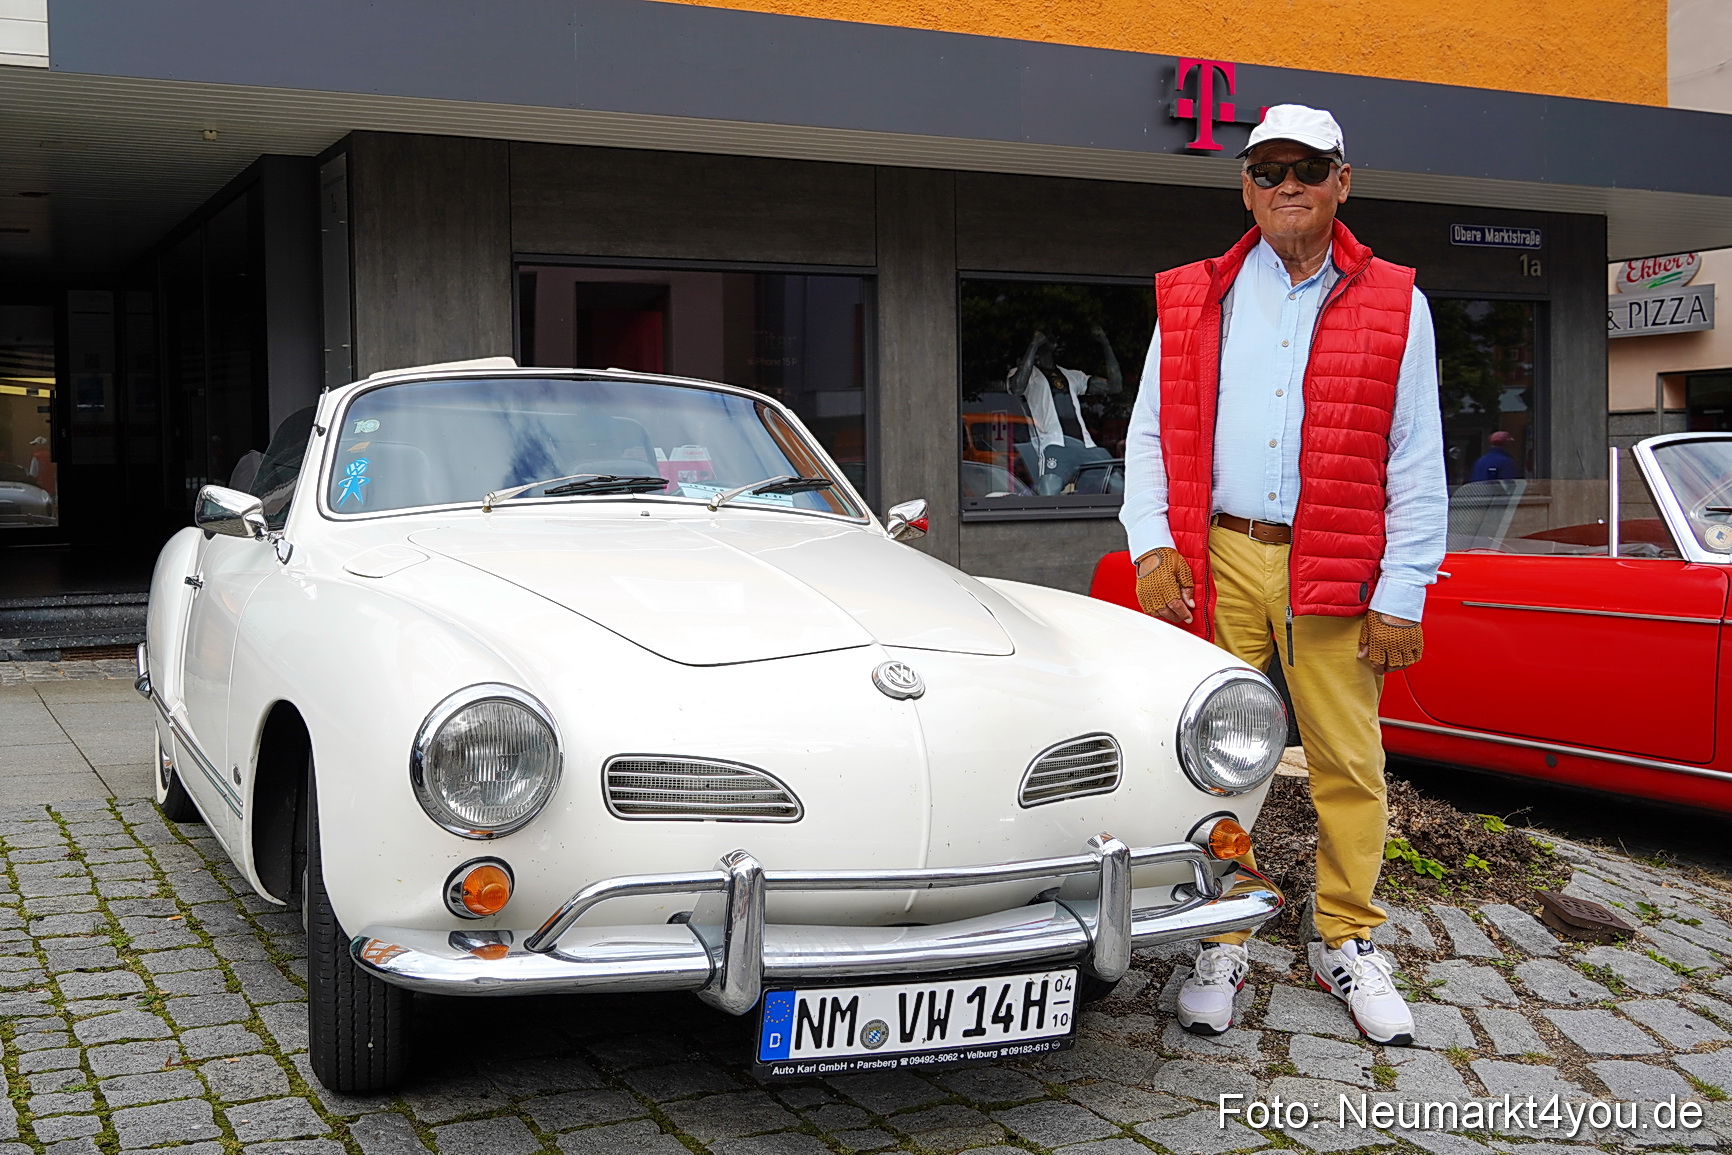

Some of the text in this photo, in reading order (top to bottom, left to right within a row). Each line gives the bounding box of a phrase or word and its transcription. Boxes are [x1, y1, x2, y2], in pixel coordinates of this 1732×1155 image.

[1177, 57, 1235, 151] T
[1454, 226, 1540, 246] Obere Marktstraße
[1520, 254, 1541, 276] 1a
[1626, 253, 1695, 283] Ekbers
[1628, 295, 1708, 329] PIZZA
[1054, 977, 1072, 993] 04
[794, 995, 859, 1050] NM
[899, 988, 954, 1043] VW
[962, 979, 1049, 1038] 14H
[1052, 1012, 1069, 1028] 10
[770, 1032, 780, 1048] D
[772, 1043, 1049, 1075] Auto Karl GmbH Parsberg 09492-5062 Velburg 09182-613
